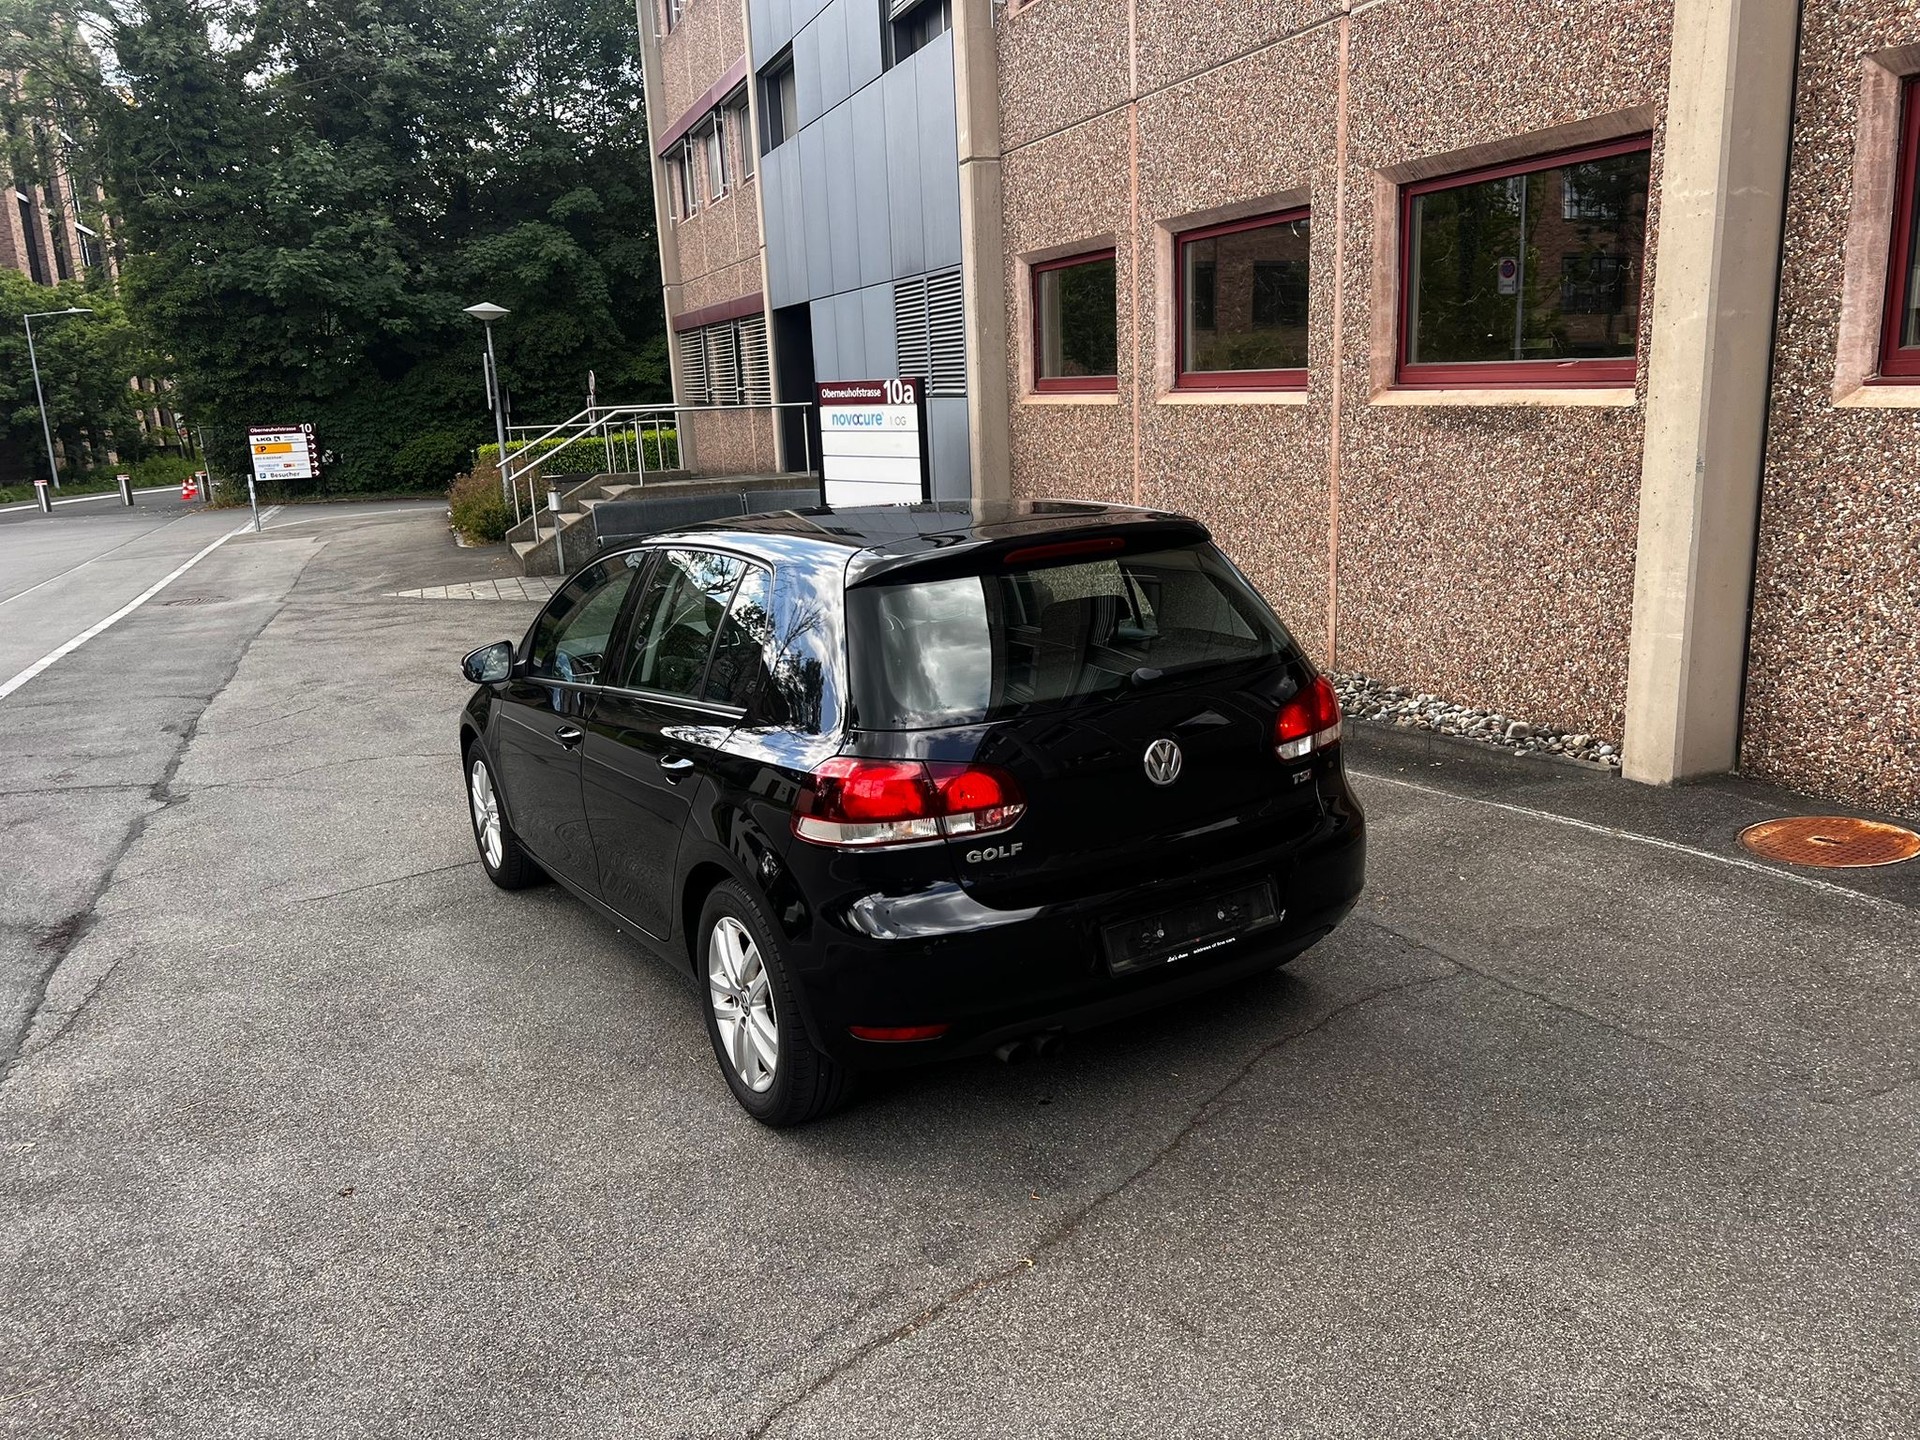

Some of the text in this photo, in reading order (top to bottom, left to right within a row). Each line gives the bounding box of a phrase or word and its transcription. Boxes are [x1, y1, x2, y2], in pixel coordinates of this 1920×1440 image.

[821, 379, 914, 404] Oberneuhofstrasse 10a
[832, 412, 883, 426] novocure
[299, 423, 312, 433] 10
[966, 842, 1023, 863] GOLF
